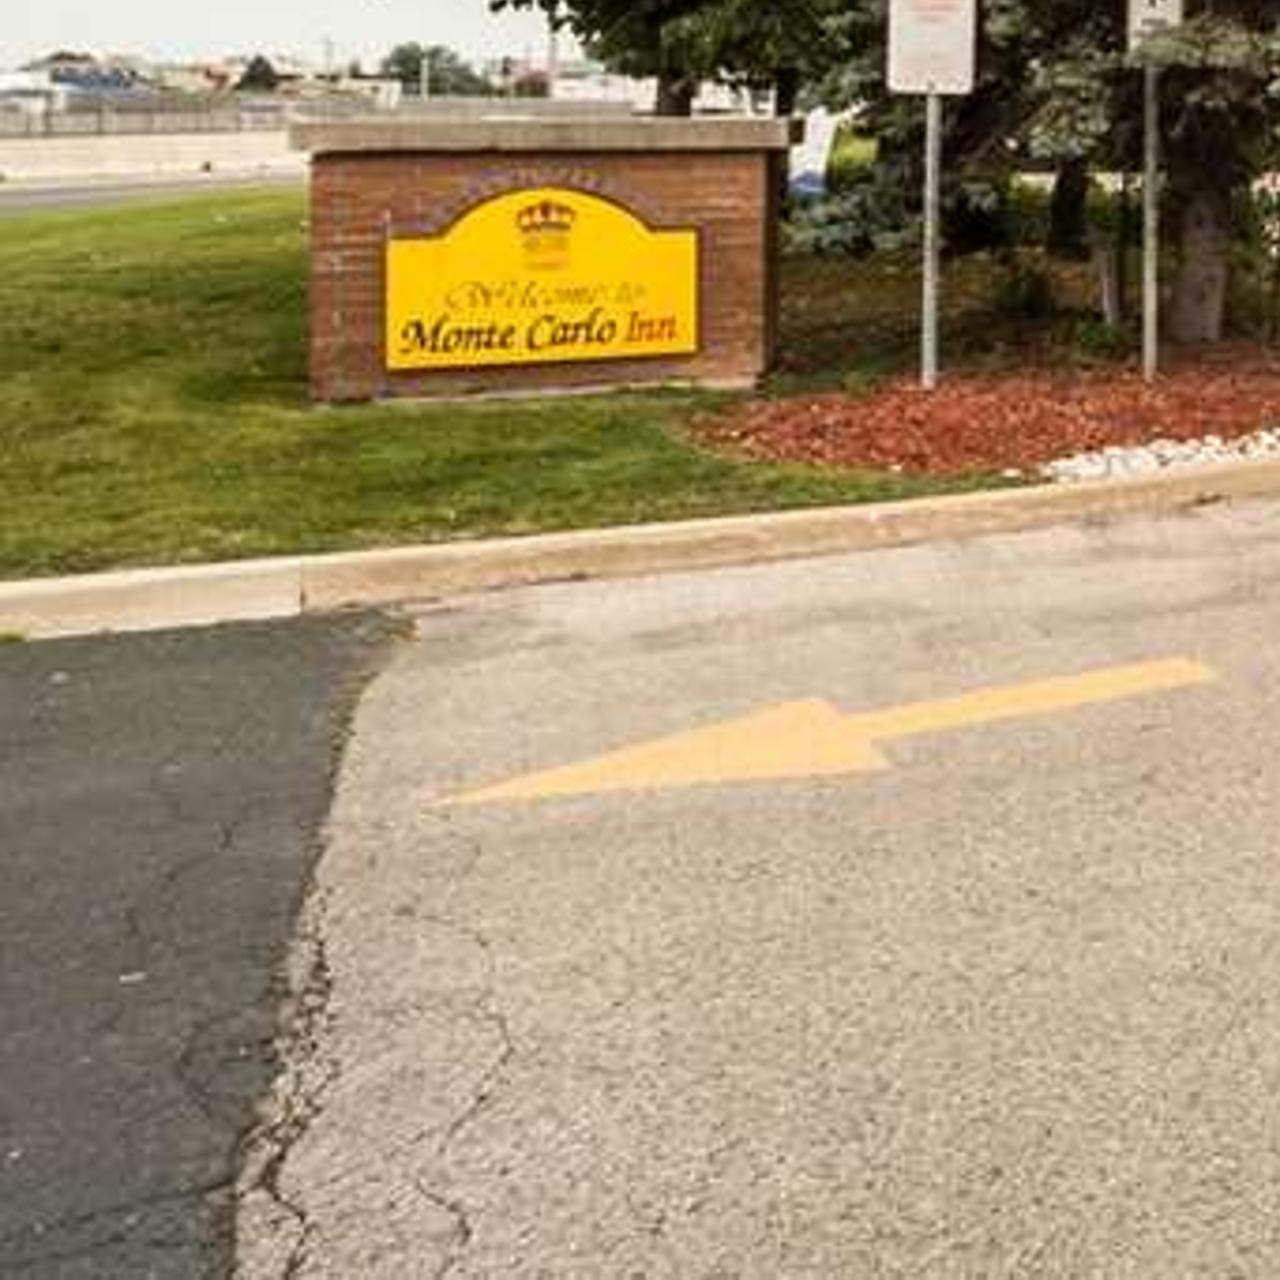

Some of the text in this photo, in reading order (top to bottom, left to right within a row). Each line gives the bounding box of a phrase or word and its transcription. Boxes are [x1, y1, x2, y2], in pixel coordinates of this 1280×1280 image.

[398, 307, 678, 354] Monte Carlo Inn
